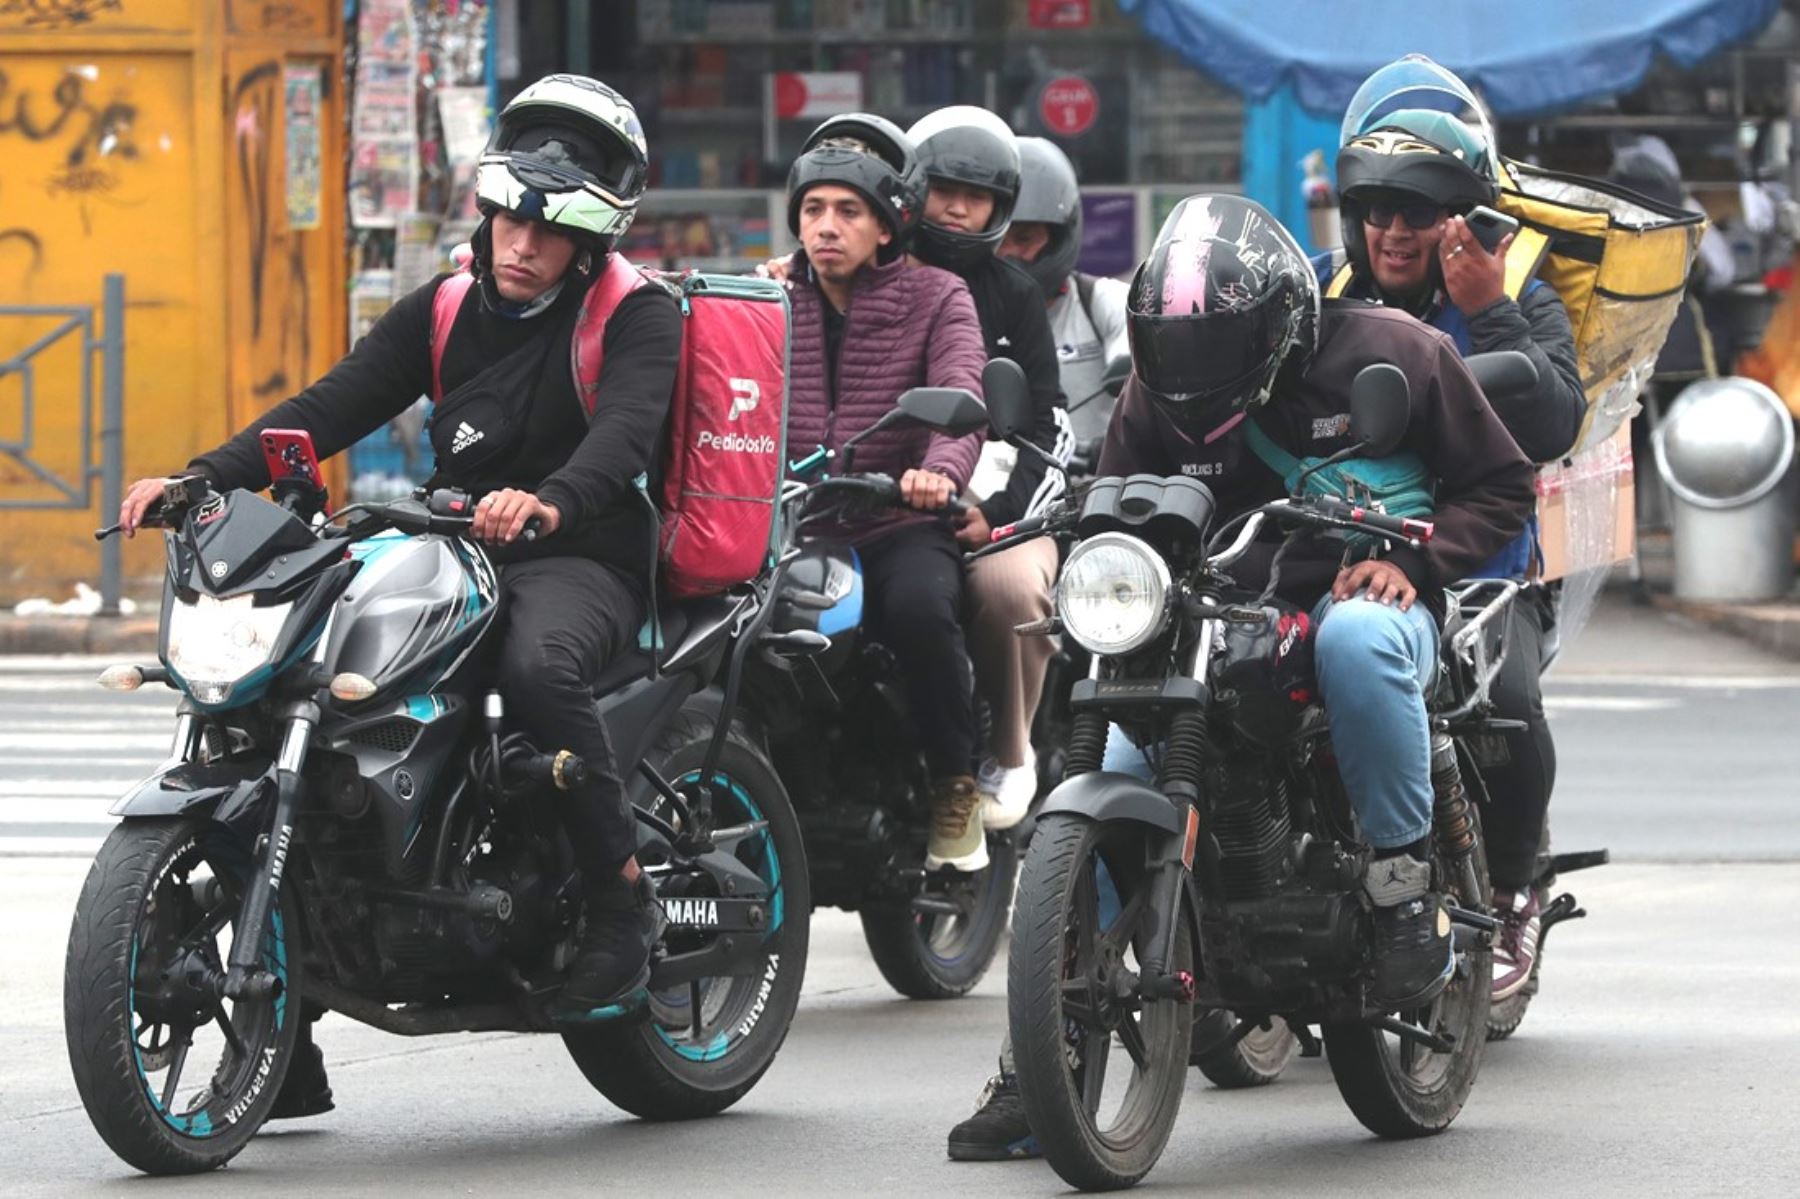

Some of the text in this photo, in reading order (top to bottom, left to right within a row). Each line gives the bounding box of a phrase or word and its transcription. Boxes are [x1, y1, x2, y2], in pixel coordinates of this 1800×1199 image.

[728, 377, 760, 422] P
[452, 431, 484, 454] adidas
[660, 899, 719, 925] MAHA
[739, 954, 779, 1036] YAMAHA
[225, 1048, 276, 1124] YAMAHA
